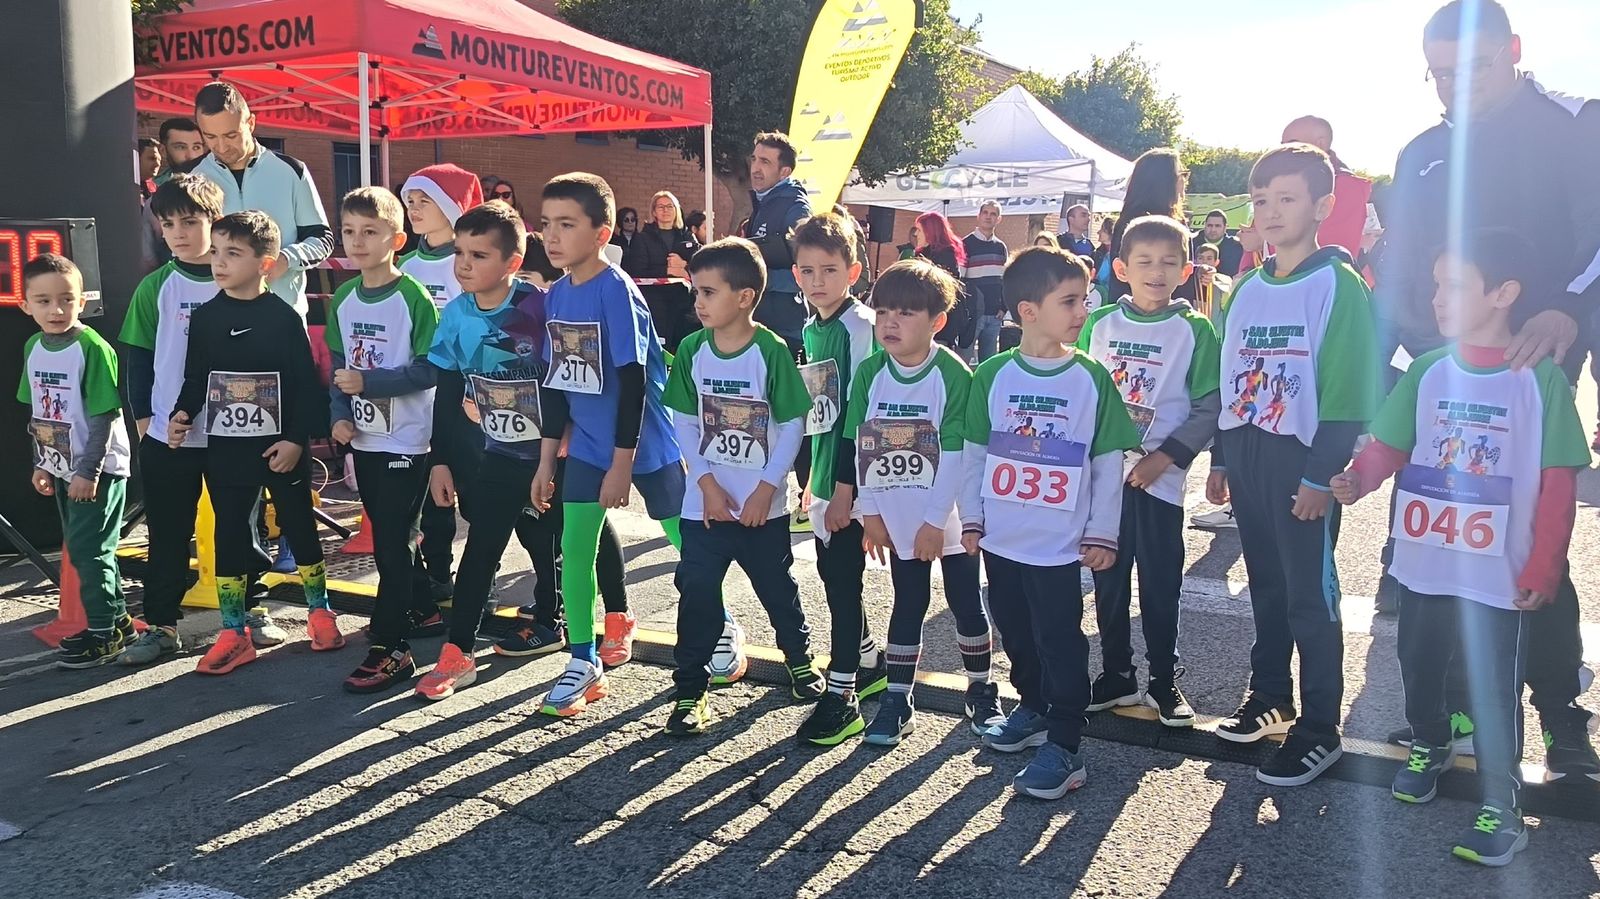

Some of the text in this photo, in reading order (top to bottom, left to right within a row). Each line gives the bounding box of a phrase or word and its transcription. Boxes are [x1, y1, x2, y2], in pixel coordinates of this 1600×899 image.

[451, 31, 684, 110] MONTUREVENTOS.COM
[896, 168, 1029, 191] GEOCYCLE
[561, 359, 588, 383] 377
[222, 407, 264, 428] 394
[350, 399, 375, 423] 69
[488, 413, 526, 433] 376
[812, 398, 831, 424] 391
[716, 432, 755, 458] 397
[389, 461, 409, 469] PUMA
[876, 454, 923, 476] 399
[992, 462, 1069, 504] 033
[1404, 500, 1494, 549] 046
